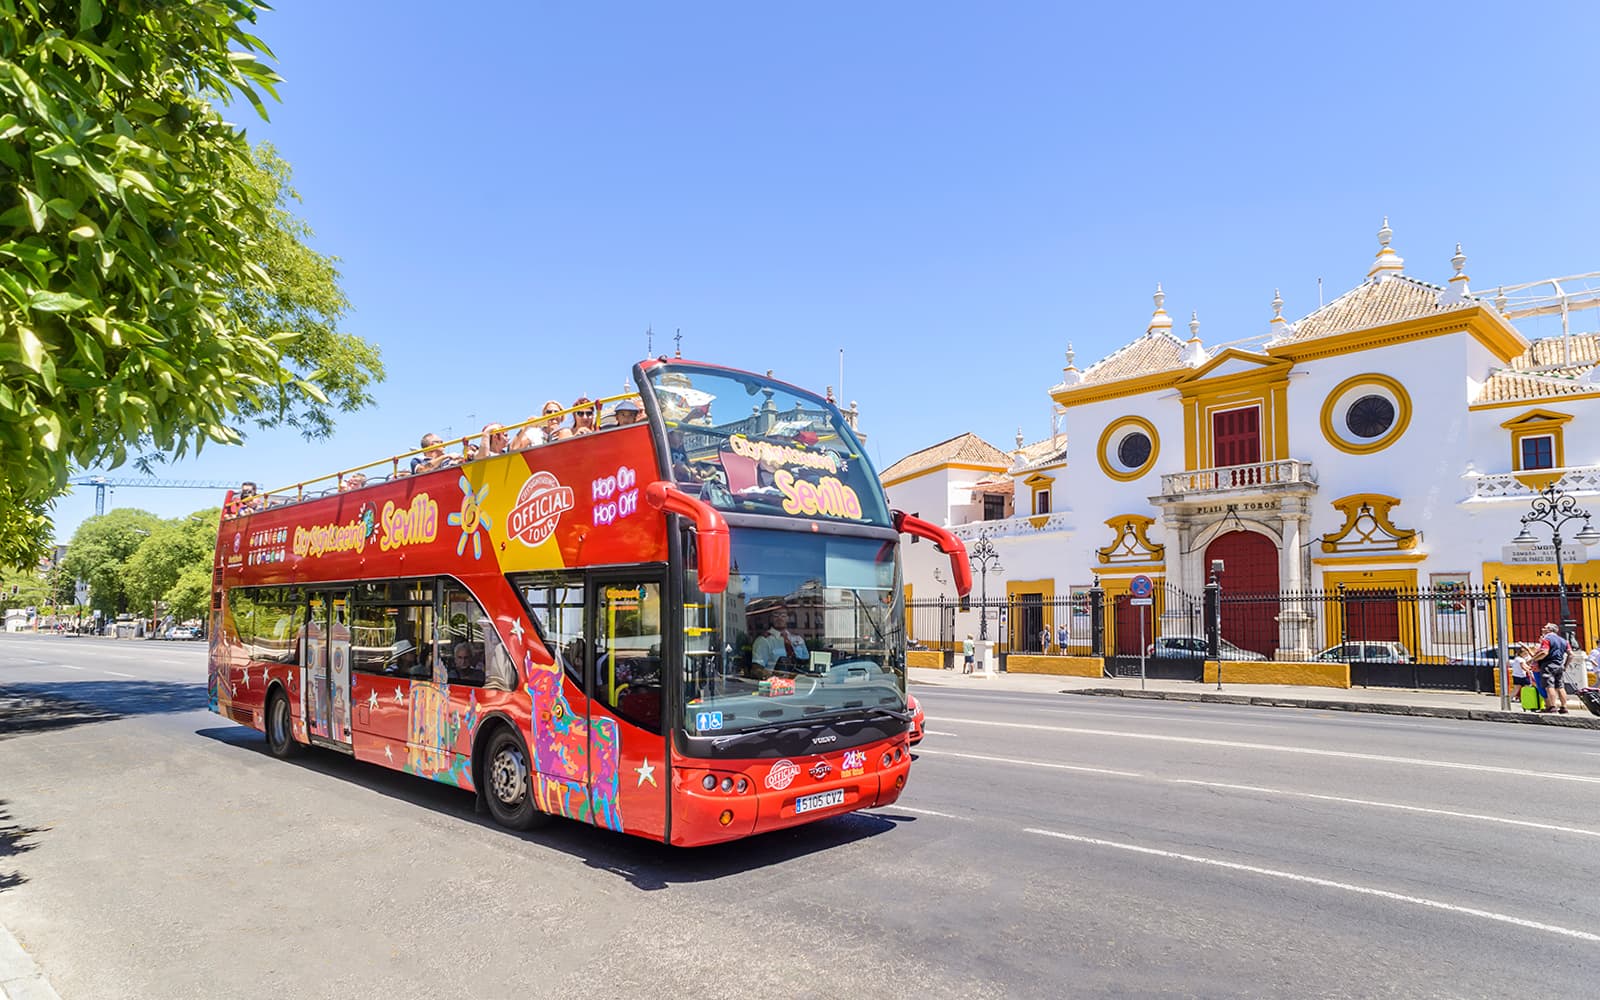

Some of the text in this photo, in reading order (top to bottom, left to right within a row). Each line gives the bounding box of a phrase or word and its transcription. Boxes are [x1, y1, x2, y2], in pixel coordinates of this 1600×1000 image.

[592, 466, 636, 500] Hop On
[774, 470, 862, 519] Sevilla
[513, 490, 570, 532] OFFICIAL
[593, 488, 639, 527] Hop Off
[1243, 502, 1276, 510] TOROS
[380, 493, 438, 551] Sevilla
[528, 518, 555, 541] TOUR
[812, 735, 837, 745] VOLVO
[768, 764, 799, 784] OFFICIAL
[802, 791, 843, 810] 5105 CVZ
